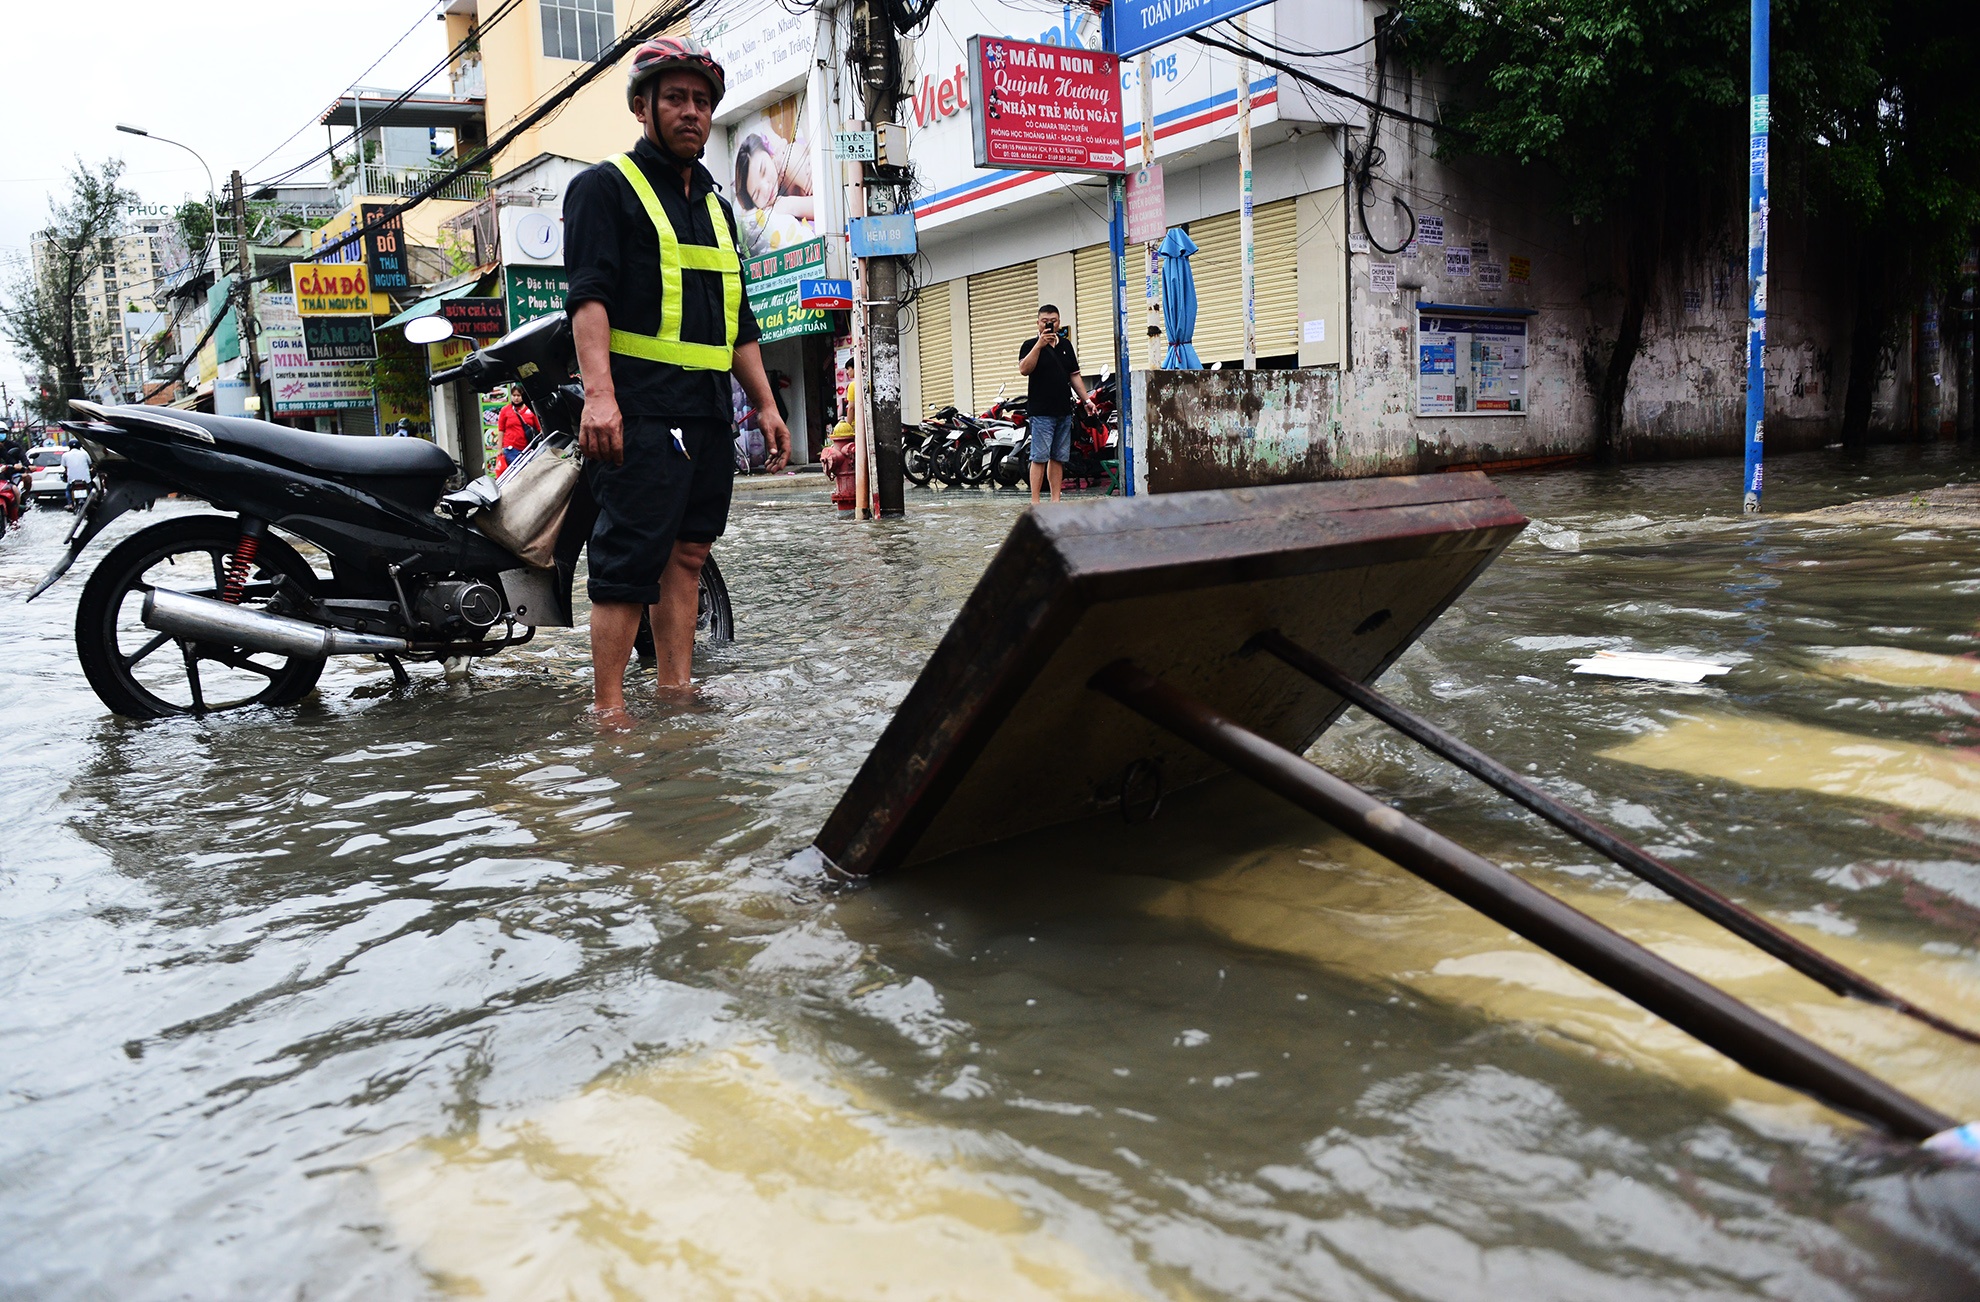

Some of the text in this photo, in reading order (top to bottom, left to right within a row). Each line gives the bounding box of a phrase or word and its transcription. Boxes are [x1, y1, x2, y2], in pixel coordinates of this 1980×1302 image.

[1009, 48, 1094, 74] MẦM NON
[994, 69, 1110, 106] Quỳnh Hương
[1002, 100, 1118, 124] NHẬN TRẺ MỖI NGÀY
[847, 144, 865, 153] 9.5
[127, 202, 169, 216] PHÚC
[376, 231, 397, 253] ĐỒ
[889, 229, 901, 240] 89
[379, 254, 399, 270] THÁI
[299, 267, 366, 295] CẦM ĐỒ
[374, 271, 407, 287] NGUYÊN
[526, 276, 542, 292] Đặc
[545, 279, 556, 292] trị
[812, 282, 842, 295] ATM
[302, 296, 326, 310] THÁI
[328, 296, 368, 310] NGUYÊN
[445, 303, 467, 317] BÚN
[528, 294, 563, 311] Phục hồi
[766, 310, 784, 328] GIÁ
[804, 320, 828, 332] TUẦN
[271, 338, 290, 349] CỬA
[310, 343, 373, 358] THÁI NGUYÊN
